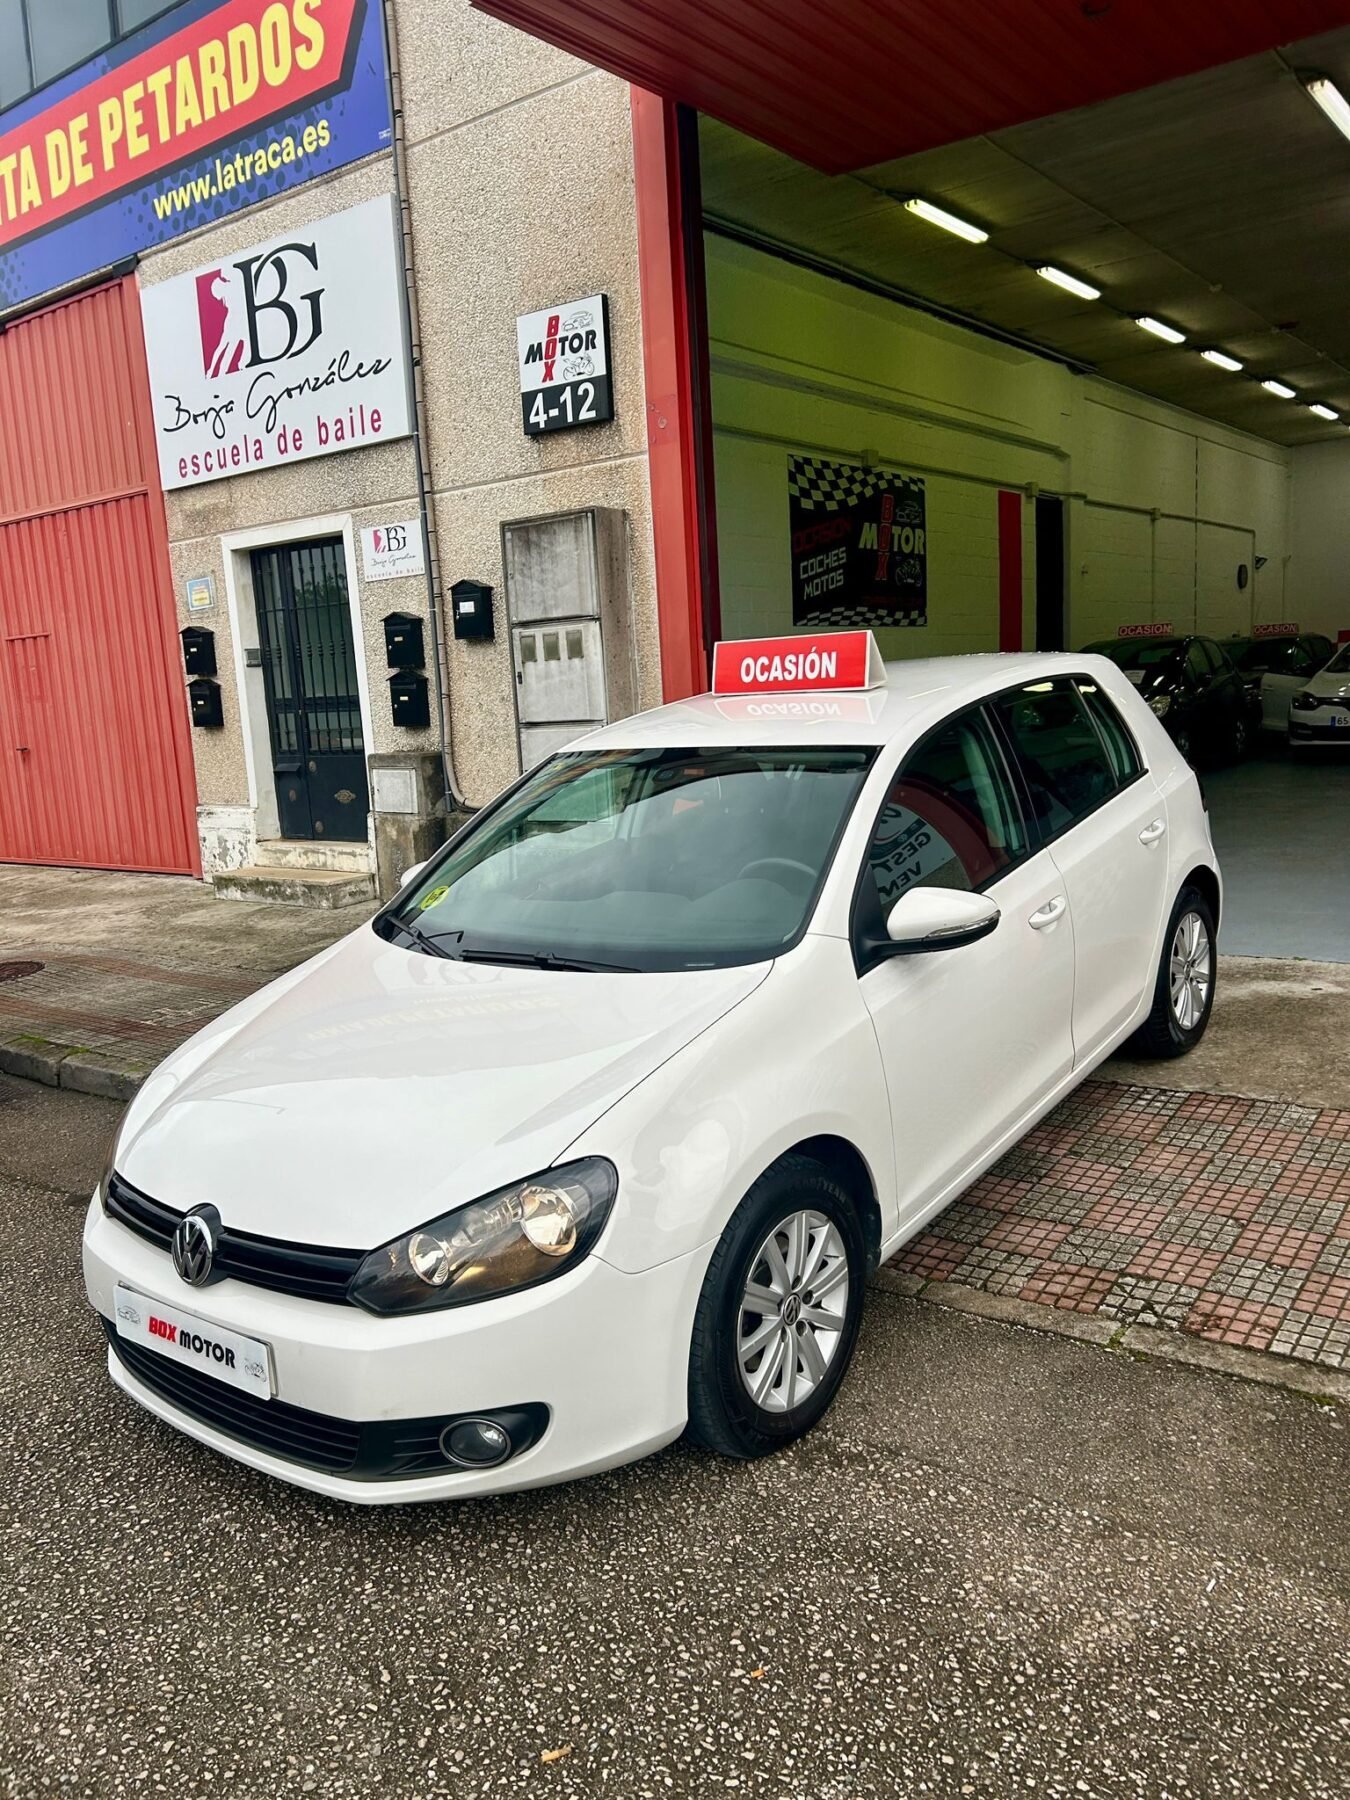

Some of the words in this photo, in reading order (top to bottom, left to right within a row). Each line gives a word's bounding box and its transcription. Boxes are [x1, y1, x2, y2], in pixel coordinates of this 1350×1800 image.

[0, 144, 43, 226] TA
[45, 112, 94, 200] DE
[98, 0, 325, 172] PETARDOS
[153, 118, 331, 221] www.latraca.es
[524, 329, 597, 365] MOTOR
[542, 315, 560, 384] BOX
[163, 394, 235, 440] Borja
[246, 350, 392, 434] González
[529, 381, 597, 429] 4-12
[178, 434, 264, 478] escuela
[277, 424, 303, 455] de
[317, 404, 382, 446] baile
[800, 546, 847, 580] COCHES
[858, 522, 925, 555] MOTOR
[803, 569, 844, 600] MOTOS
[740, 647, 837, 683] OCASIÓN
[148, 1316, 177, 1343] BOX
[179, 1329, 235, 1369] MOTOR
